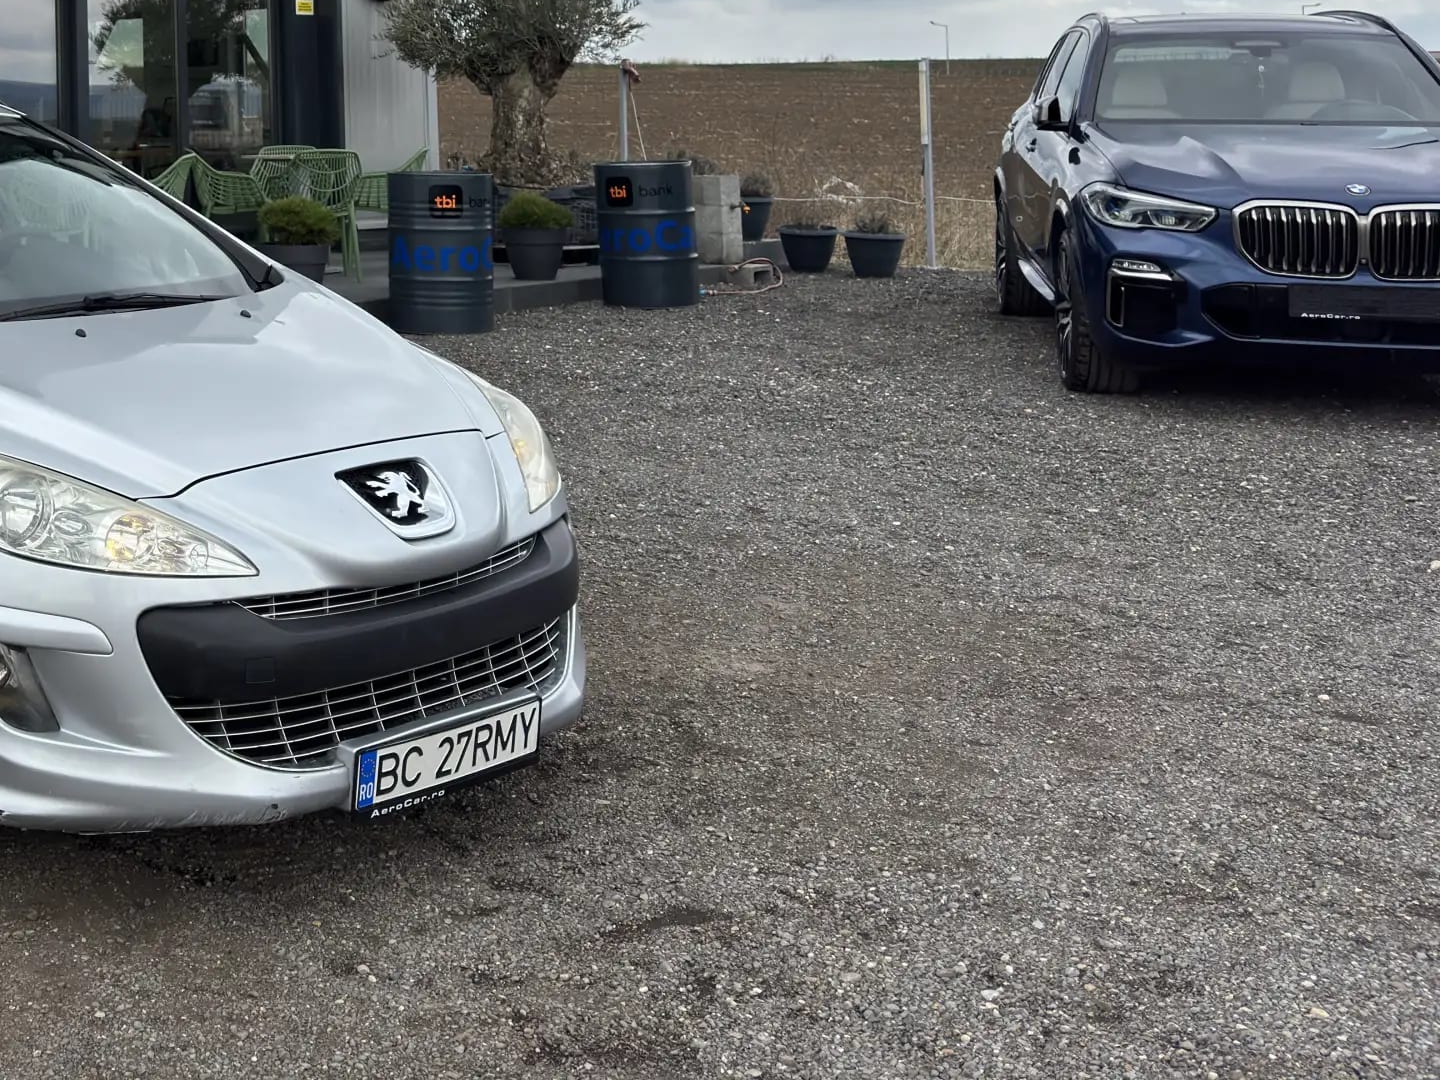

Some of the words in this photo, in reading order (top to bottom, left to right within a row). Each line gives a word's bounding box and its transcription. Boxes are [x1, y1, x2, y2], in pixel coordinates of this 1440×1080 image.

[434, 194, 456, 208] tbi
[609, 185, 627, 198] tbi
[639, 184, 673, 197] bank
[376, 745, 423, 797] BC
[435, 707, 537, 780] 27RMY
[360, 780, 374, 801] RO
[370, 789, 446, 819] AeroCar.ro
